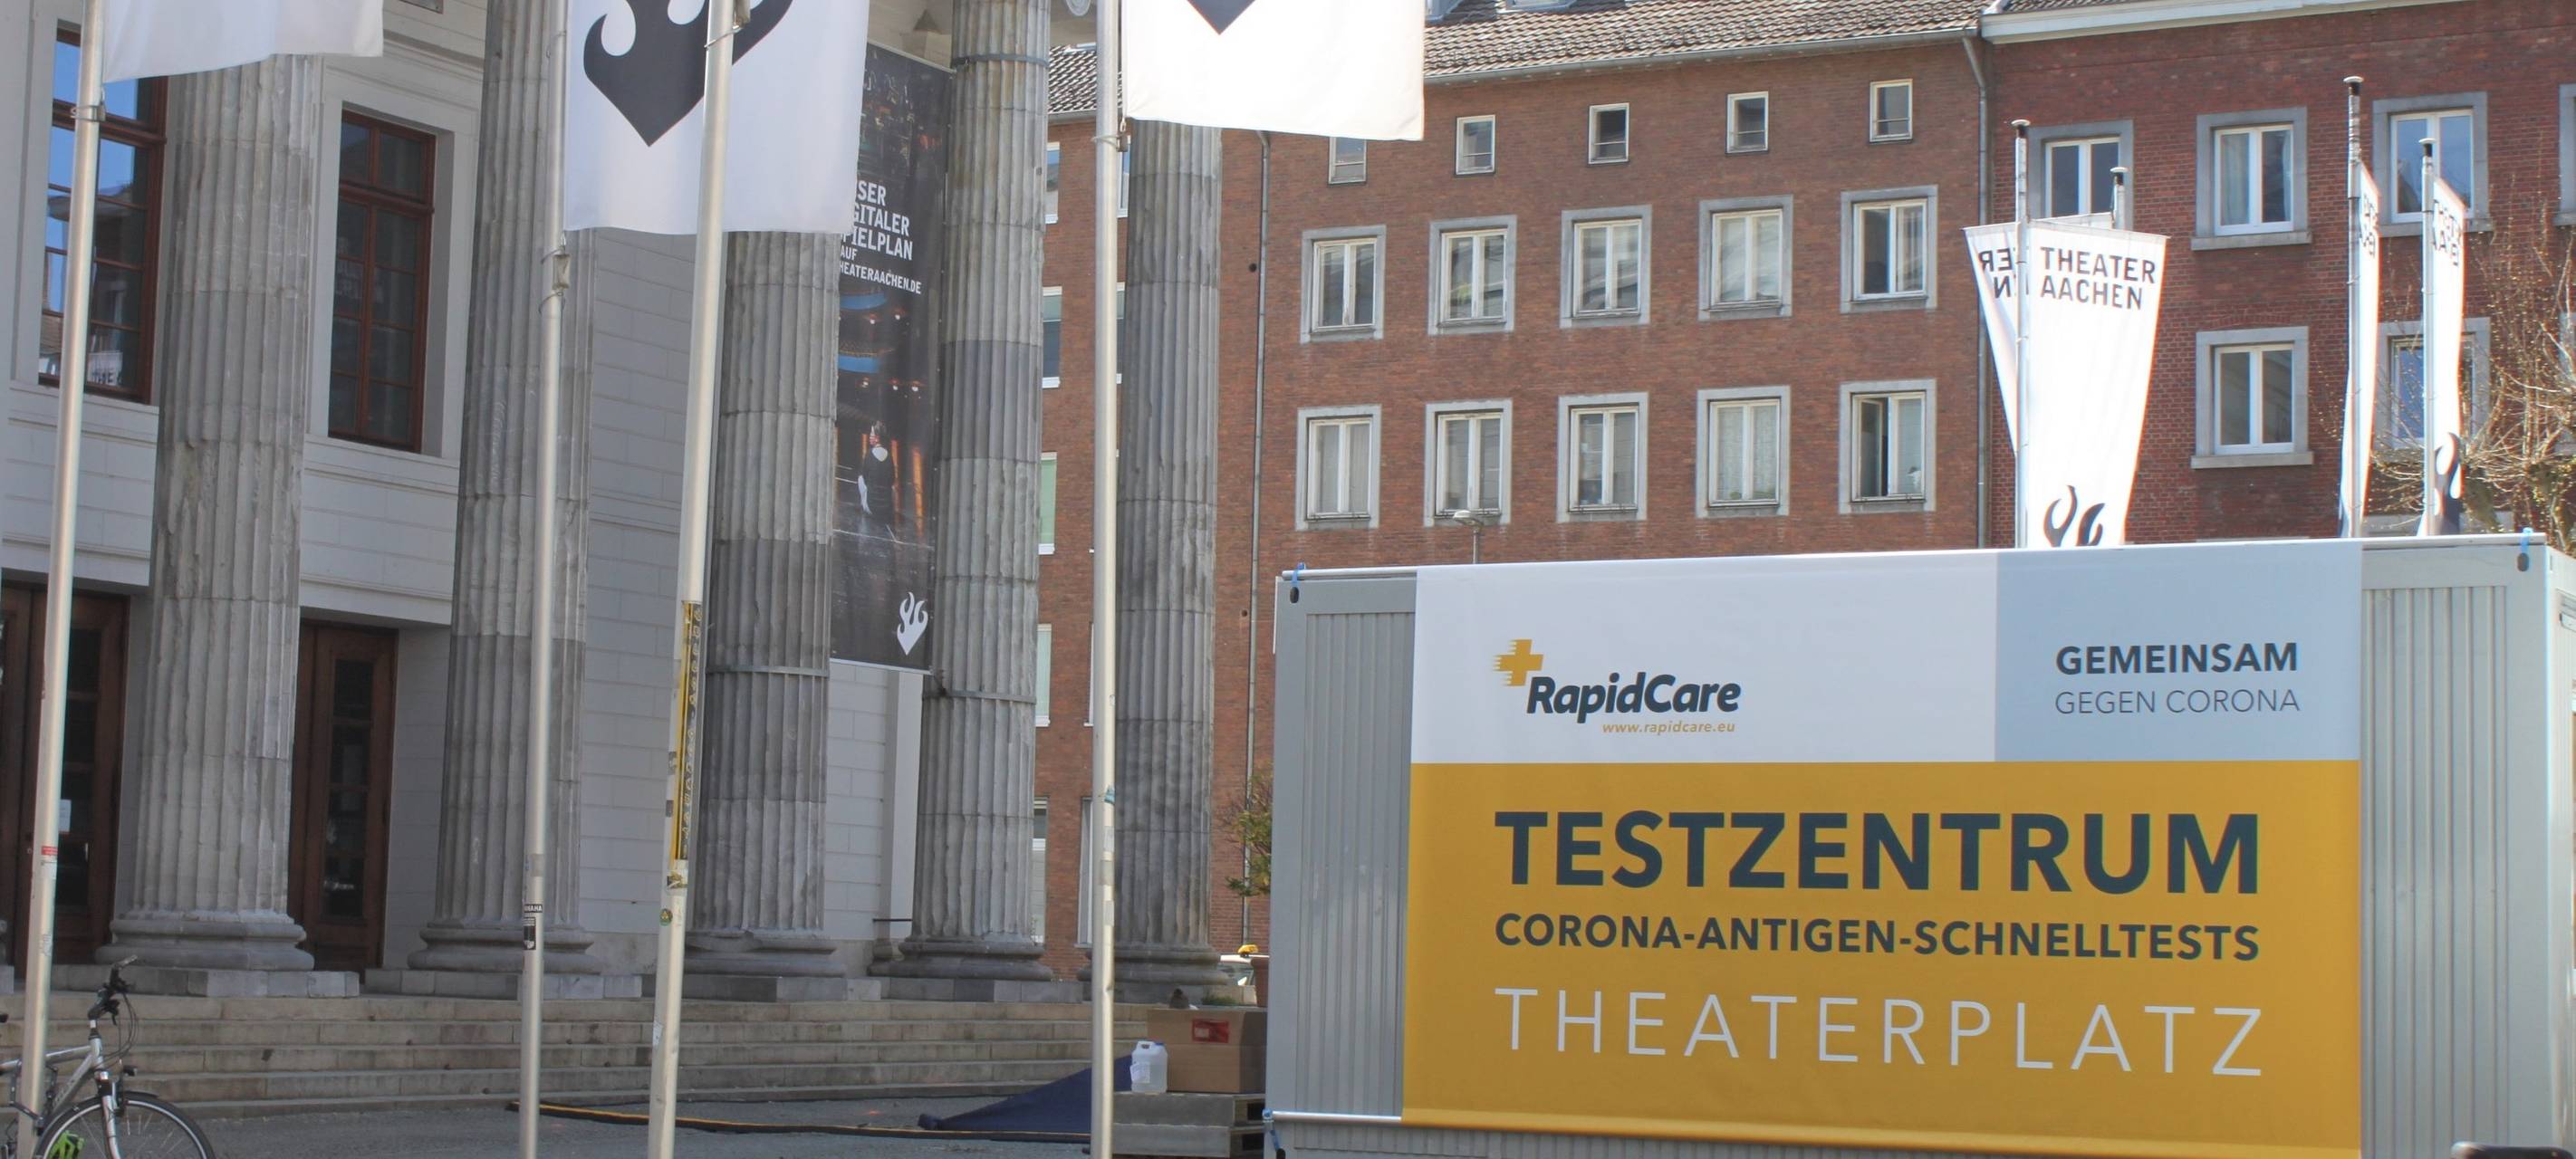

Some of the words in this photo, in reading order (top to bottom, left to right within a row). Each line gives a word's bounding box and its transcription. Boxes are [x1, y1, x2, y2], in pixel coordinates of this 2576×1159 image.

[856, 180, 887, 206] SER
[840, 225, 914, 261] IELPLAN
[840, 245, 858, 261] AUF
[2040, 246, 2156, 284] THEATER
[2040, 274, 2143, 311] AACHEN
[2056, 643, 2298, 675] GEMEINSAM
[1526, 671, 1742, 724] RapidCare
[2055, 690, 2156, 714] GEGEN
[2166, 689, 2301, 714] CORONA
[1602, 720, 1735, 736] www.rapidcare.eu
[1495, 810, 2259, 895] TESTZENTRUM
[1495, 913, 2260, 961] CORONA-ANTIGEN-SCHNELLTESTS
[1495, 987, 2262, 1078] THEATERPLATZ
